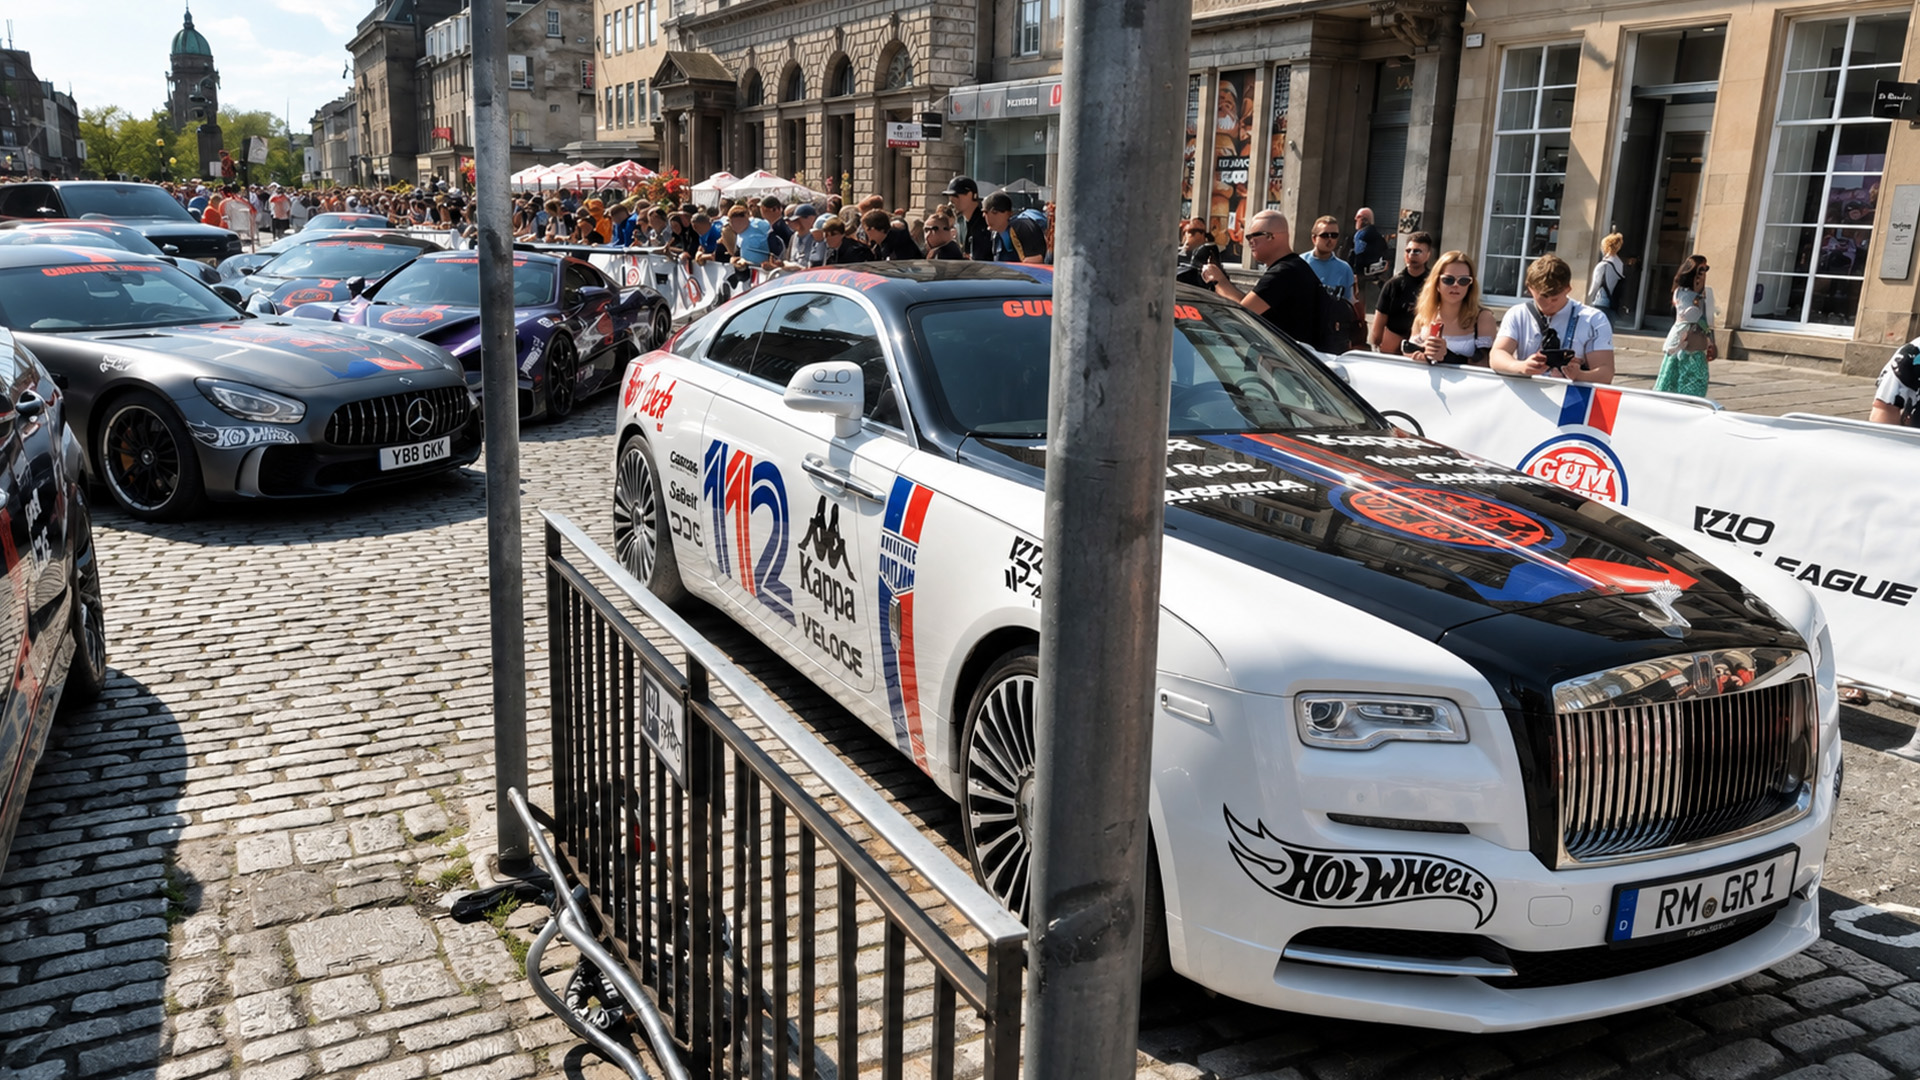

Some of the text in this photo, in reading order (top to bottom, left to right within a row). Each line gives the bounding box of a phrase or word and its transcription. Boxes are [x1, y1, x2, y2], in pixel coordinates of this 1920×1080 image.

[423, 440, 444, 459] GKK
[704, 439, 797, 627] 112
[799, 550, 856, 624] Kappa
[1753, 550, 1919, 607] EAGUE
[802, 612, 863, 678] VELOCE
[1619, 920, 1629, 931] D
[1655, 883, 1703, 930] RM
